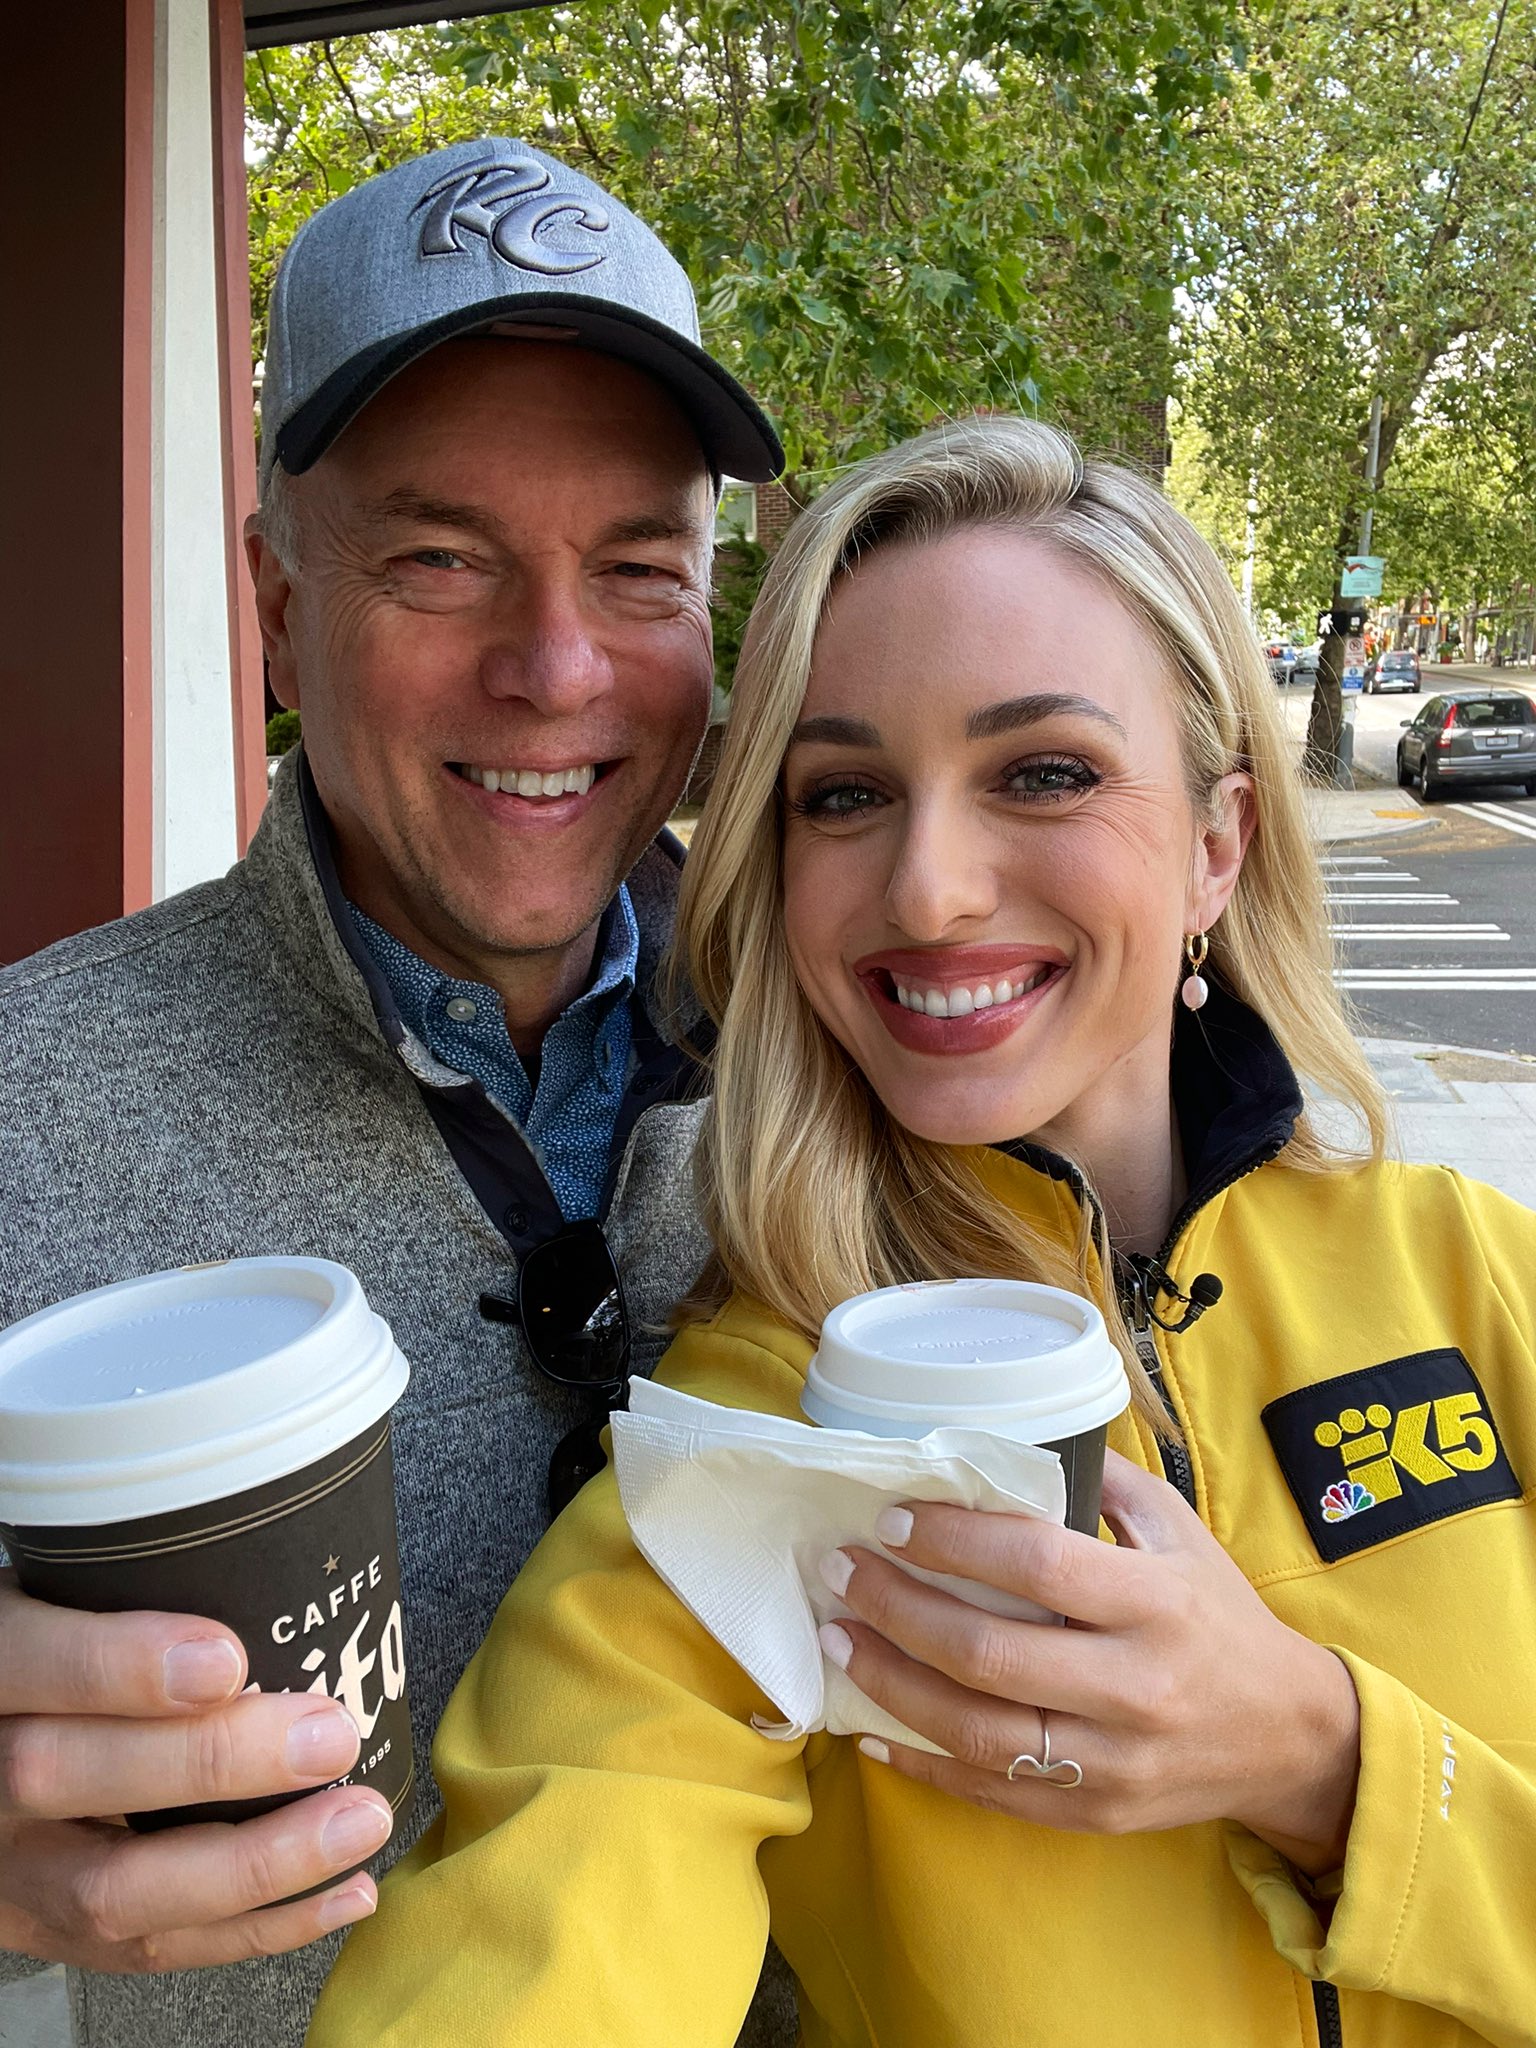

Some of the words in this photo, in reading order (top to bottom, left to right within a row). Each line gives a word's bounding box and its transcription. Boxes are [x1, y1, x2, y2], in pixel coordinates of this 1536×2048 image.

[271, 1554, 382, 1644] CAFFE
[241, 1600, 406, 1740] ito
[361, 1739, 391, 1775] 1995
